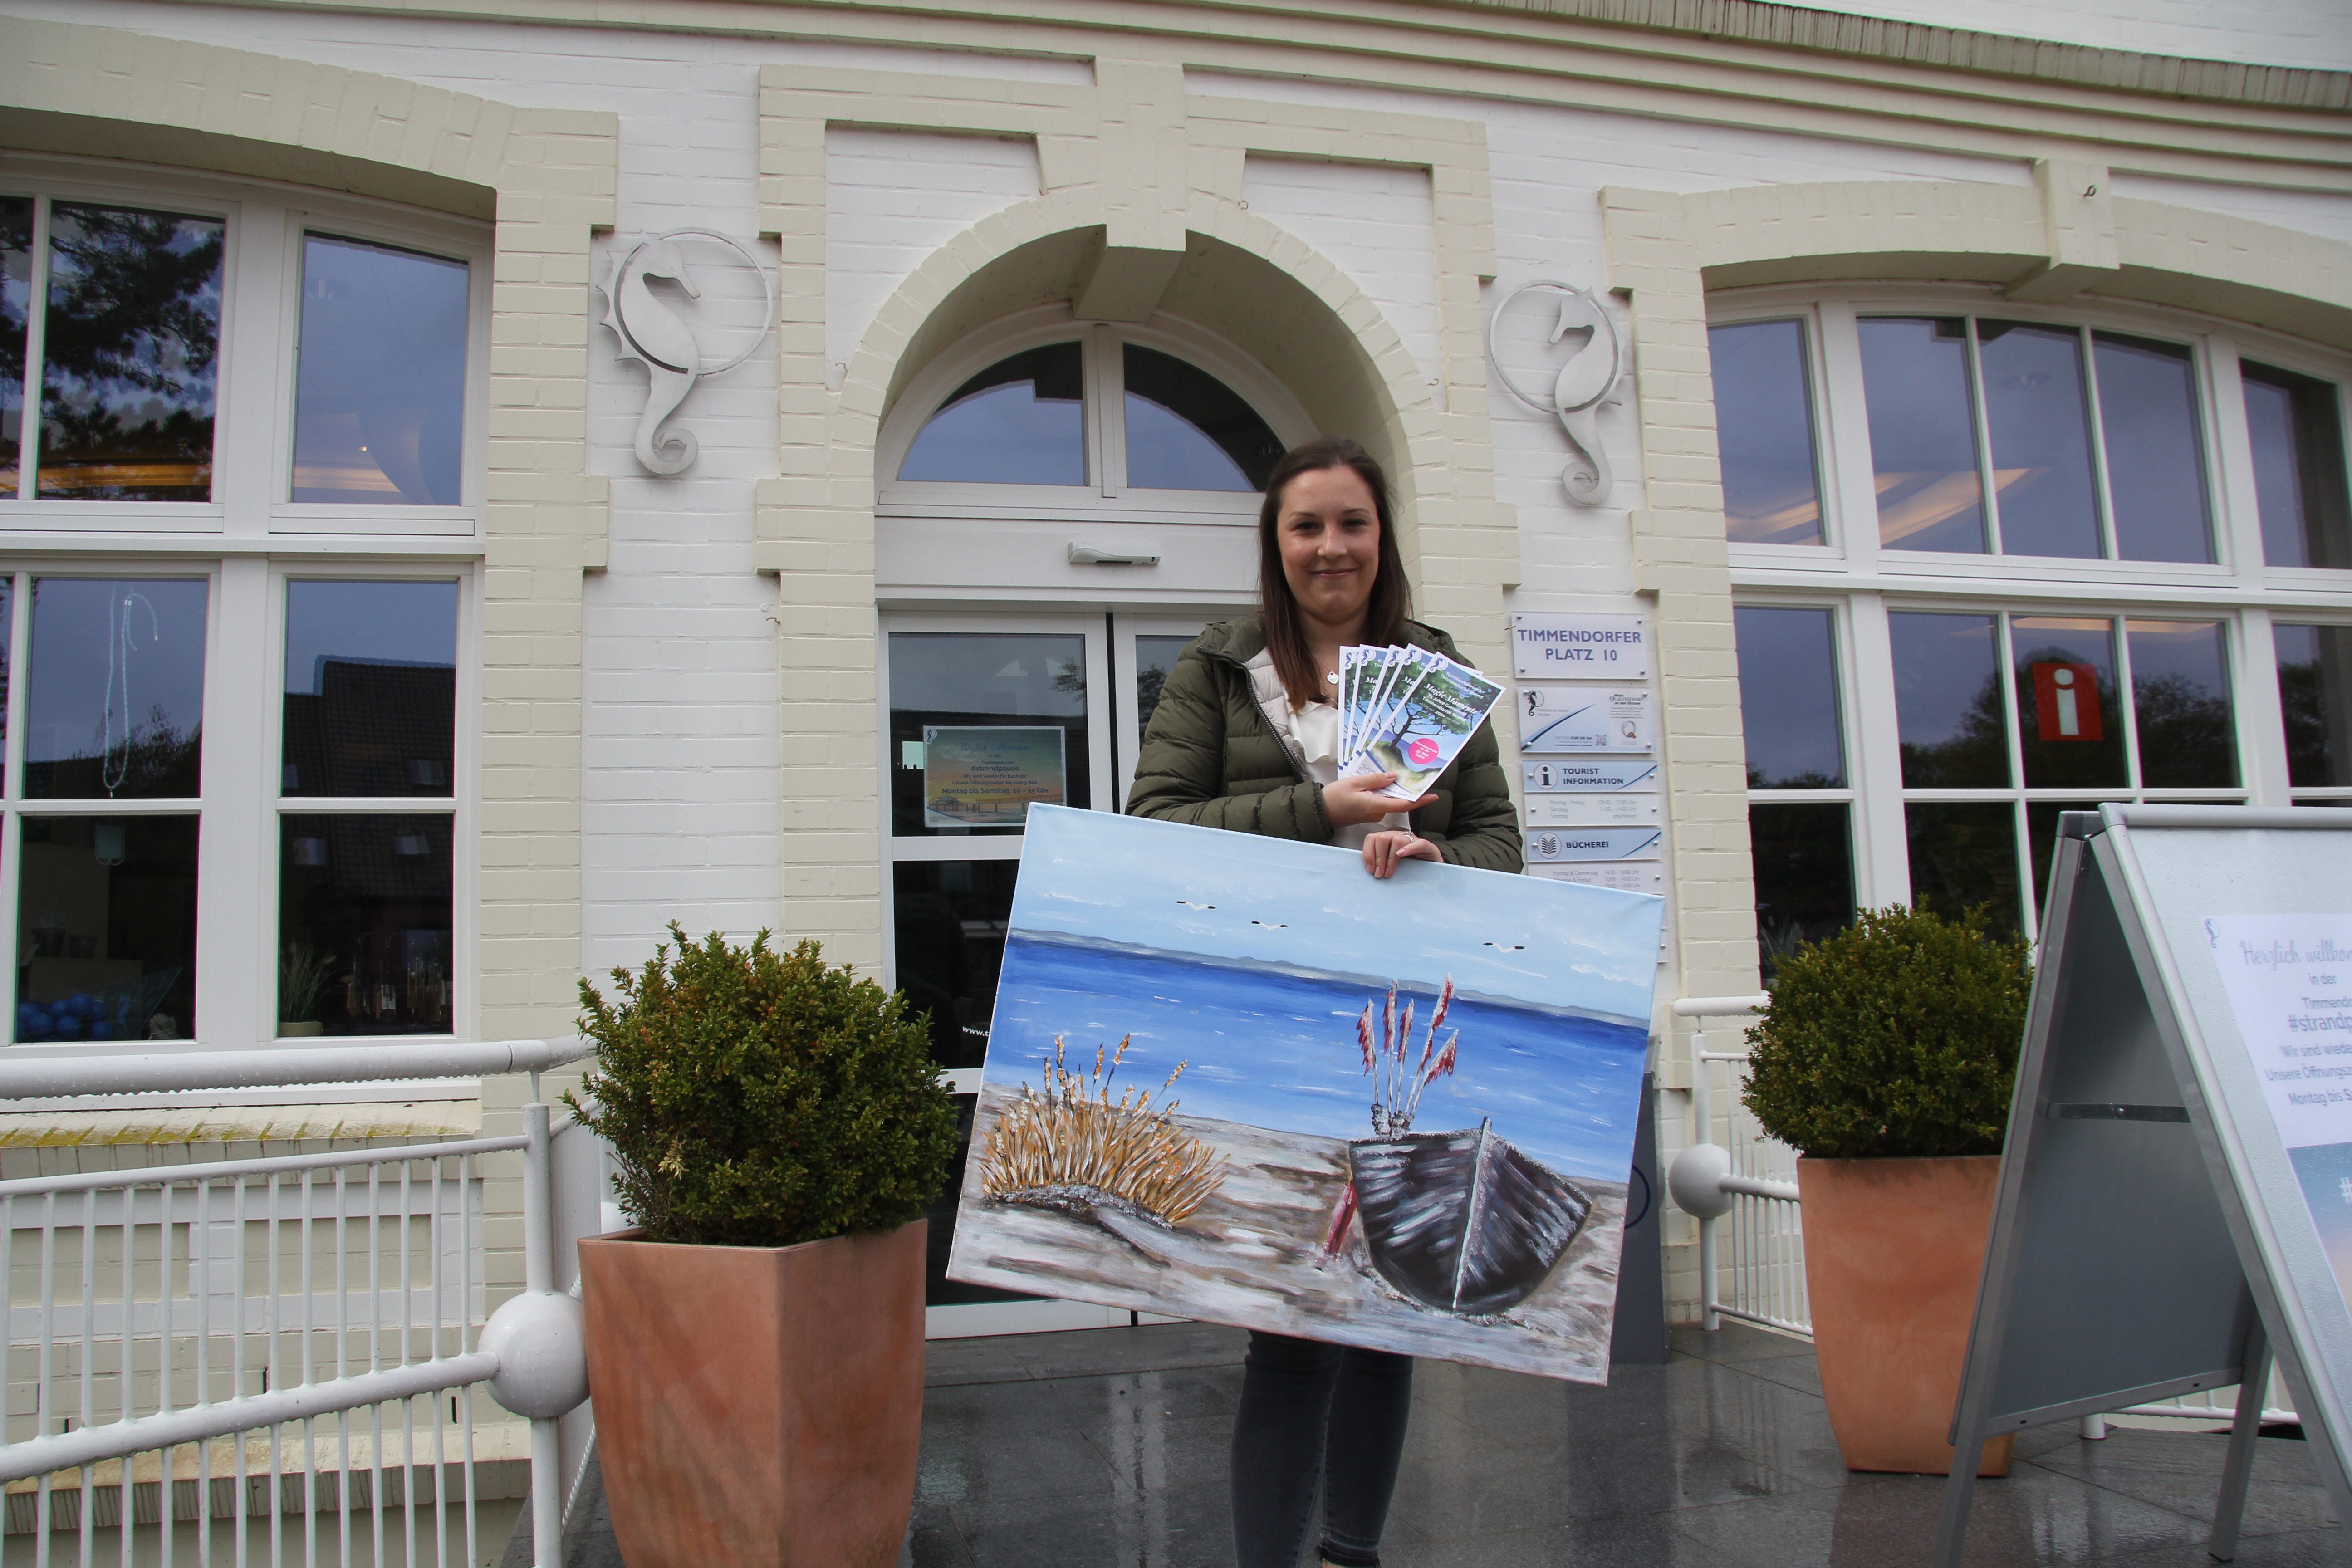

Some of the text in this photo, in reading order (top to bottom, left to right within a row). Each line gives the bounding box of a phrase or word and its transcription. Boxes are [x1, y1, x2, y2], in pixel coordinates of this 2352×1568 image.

[1518, 629, 1642, 643] TIMMENDORFER
[1545, 648, 1617, 661] PLATZ 10
[1440, 674, 1484, 700] Timmendorfer Strand
[1448, 688, 1465, 700] MOTTO
[1424, 683, 1479, 715] Magic Moments
[1432, 696, 1447, 706] Jahre
[1445, 703, 1467, 716] Gemeinde
[1422, 696, 1466, 722] Timmendorfer Strand
[1435, 710, 1446, 718] 2020
[2240, 939, 2302, 971] Herzlich
[2308, 972, 2337, 985] in der
[2279, 1044, 2300, 1058] Wir
[2300, 1043, 2323, 1057] sind
[2264, 1069, 2303, 1081] Unsere
[2287, 1091, 2328, 1106] Montag
[2326, 1089, 2343, 1102] bis
